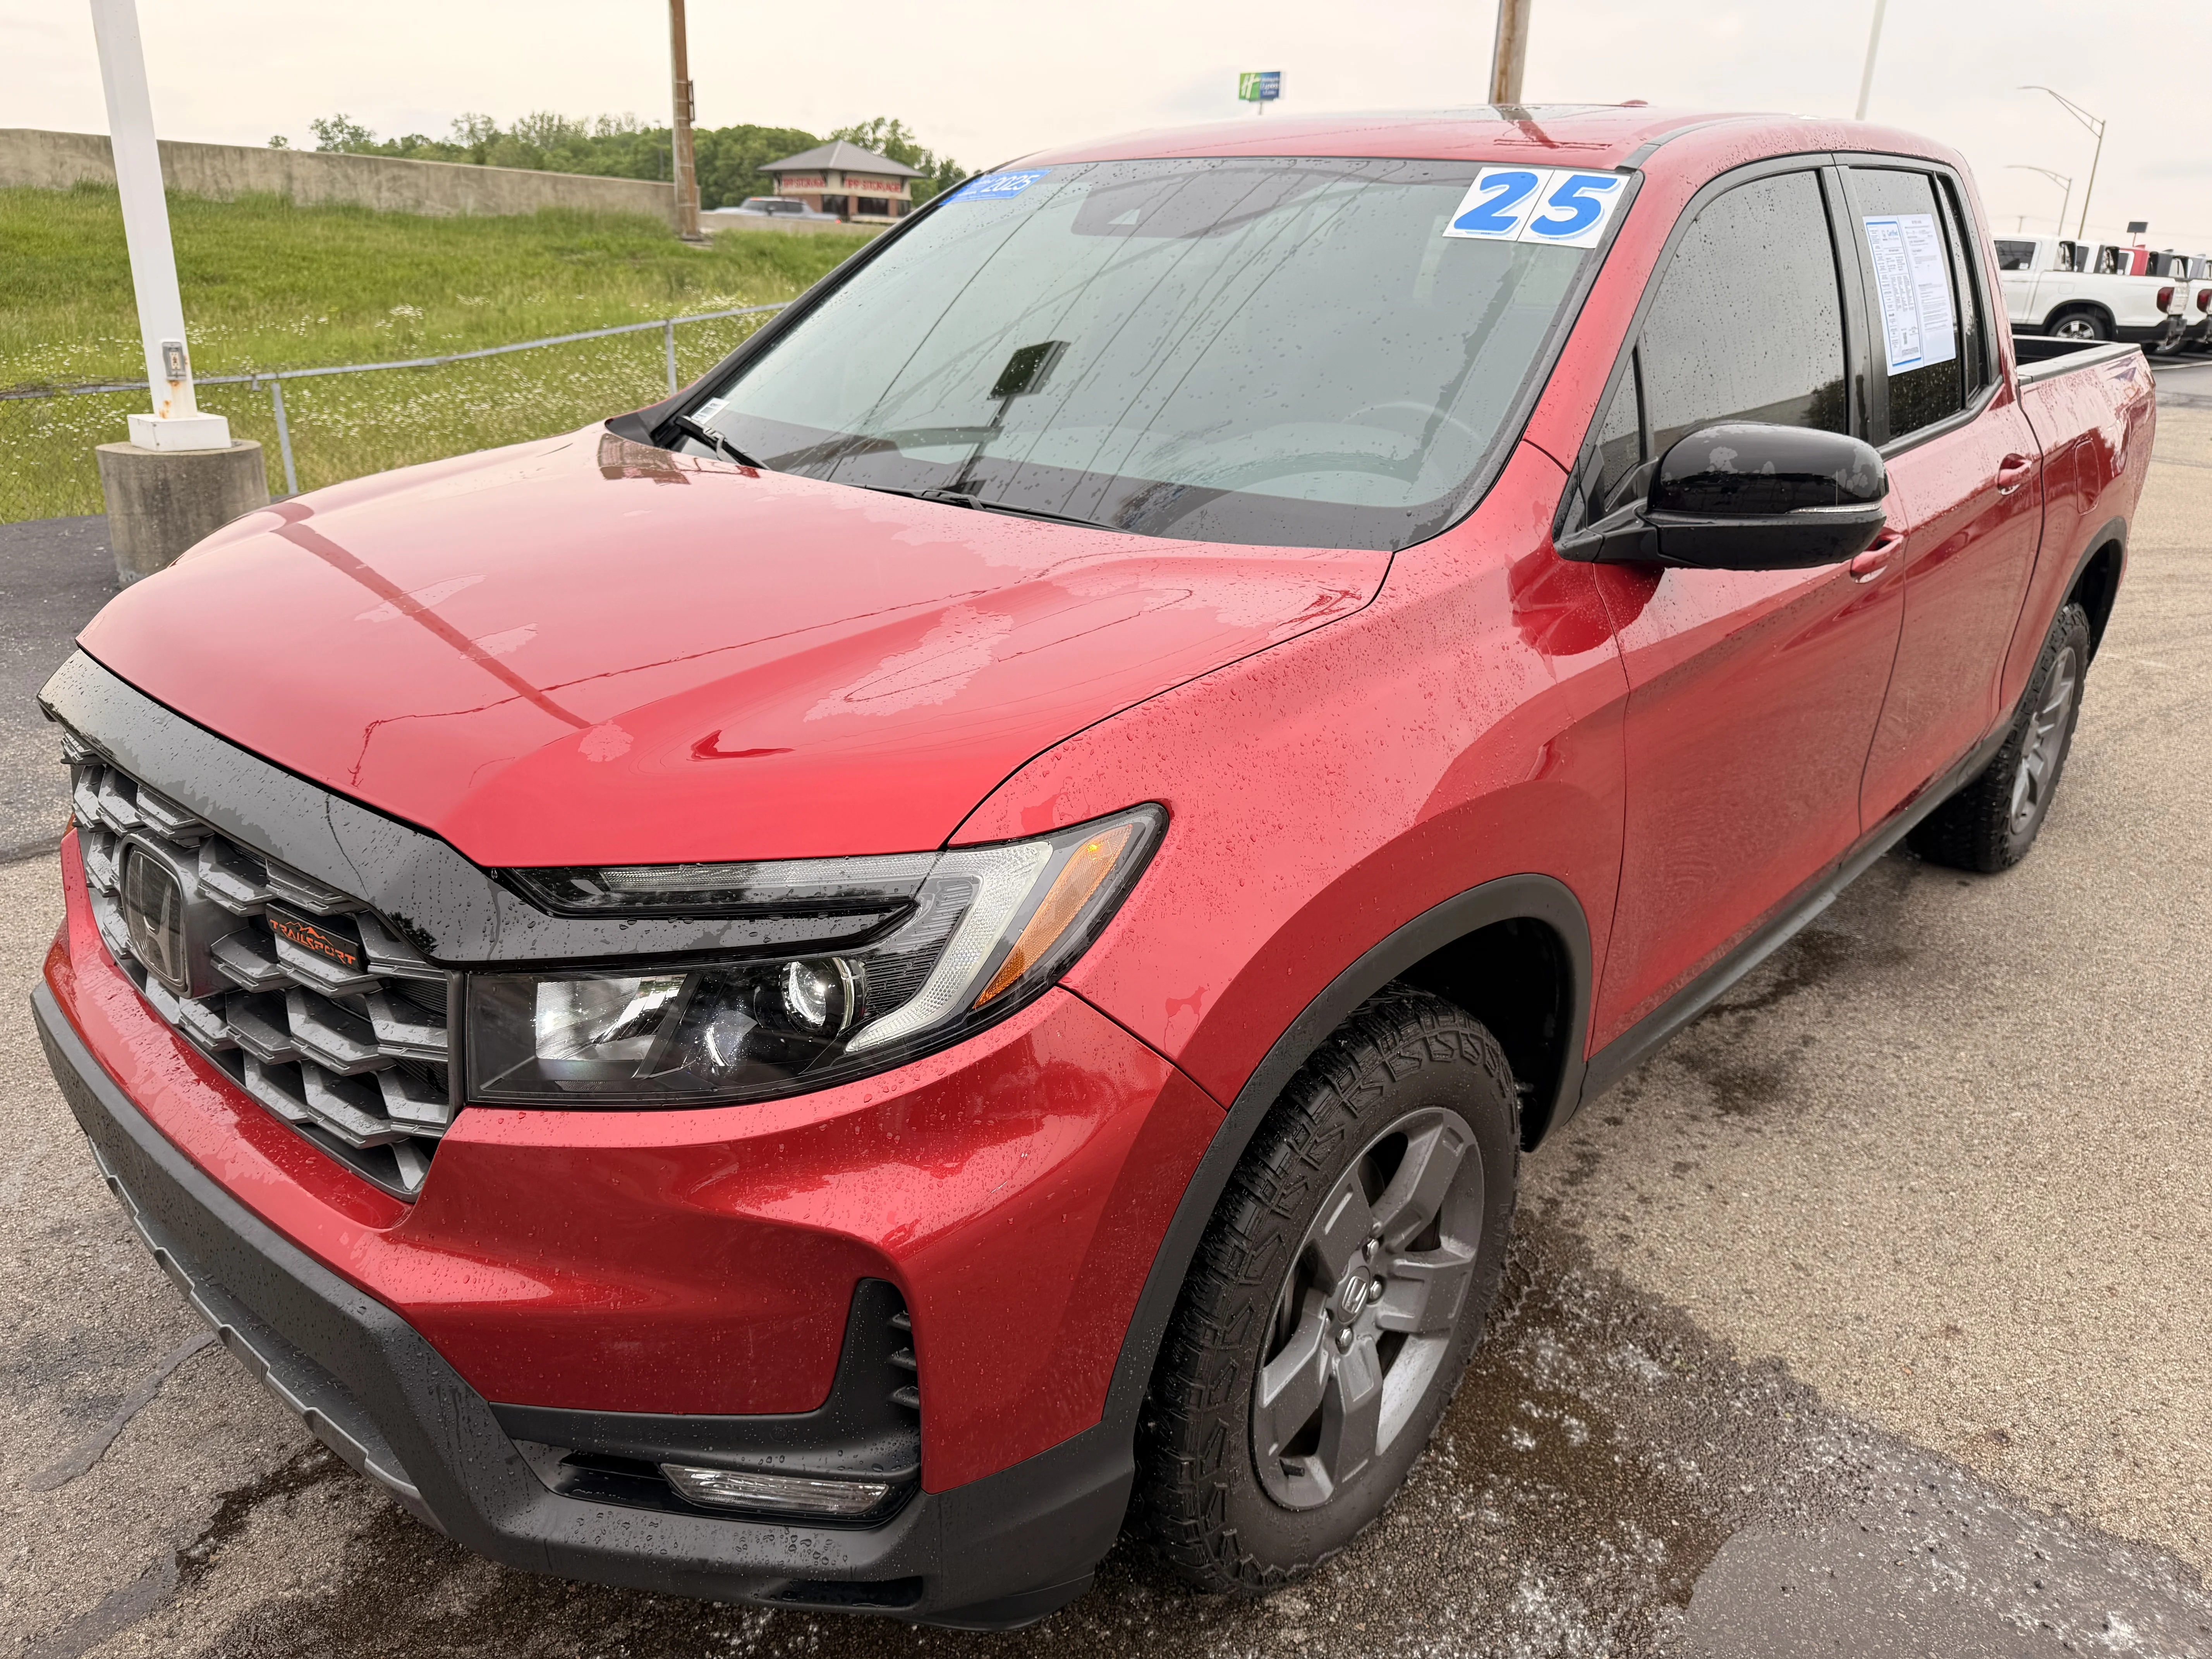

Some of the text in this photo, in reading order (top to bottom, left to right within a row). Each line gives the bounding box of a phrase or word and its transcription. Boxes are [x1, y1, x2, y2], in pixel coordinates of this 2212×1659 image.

[980, 174, 1041, 192] 2025
[1454, 172, 1620, 239] 25
[269, 919, 356, 965] TRAILSPORT
